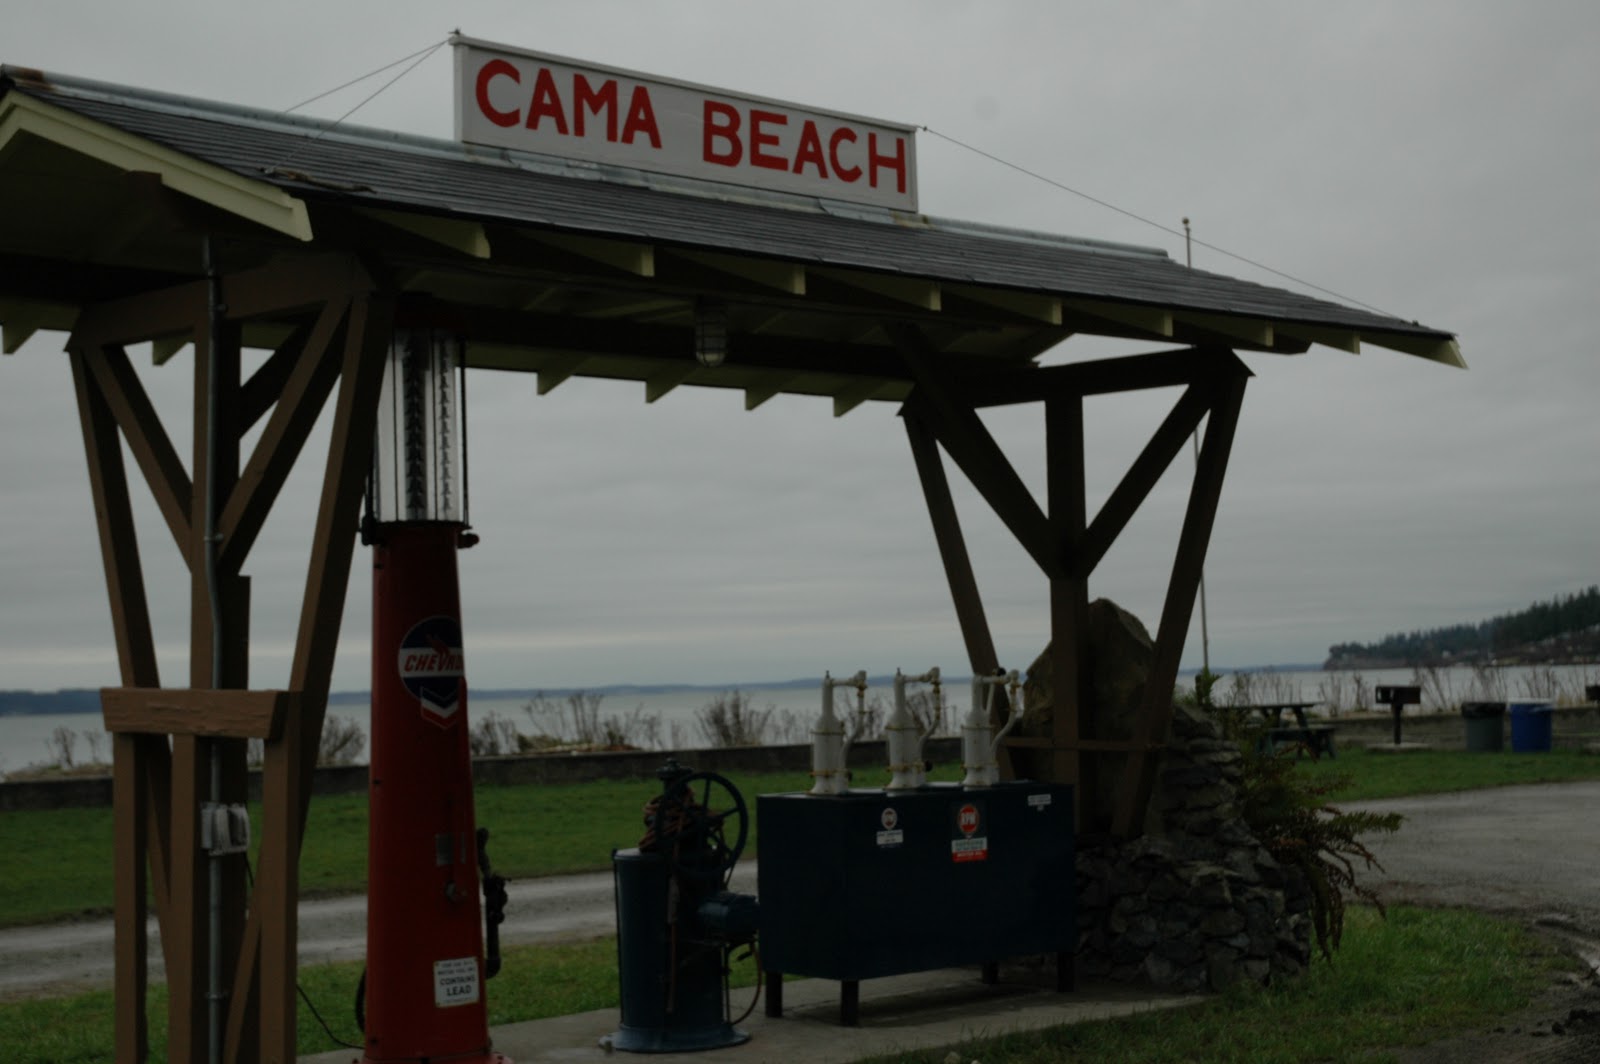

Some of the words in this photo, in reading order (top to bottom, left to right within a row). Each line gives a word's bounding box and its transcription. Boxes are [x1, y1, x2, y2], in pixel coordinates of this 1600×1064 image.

[476, 59, 662, 149] CAMA
[703, 100, 906, 193] BEACH
[440, 974, 475, 986] CONTAINS
[446, 984, 472, 997] LEAD
